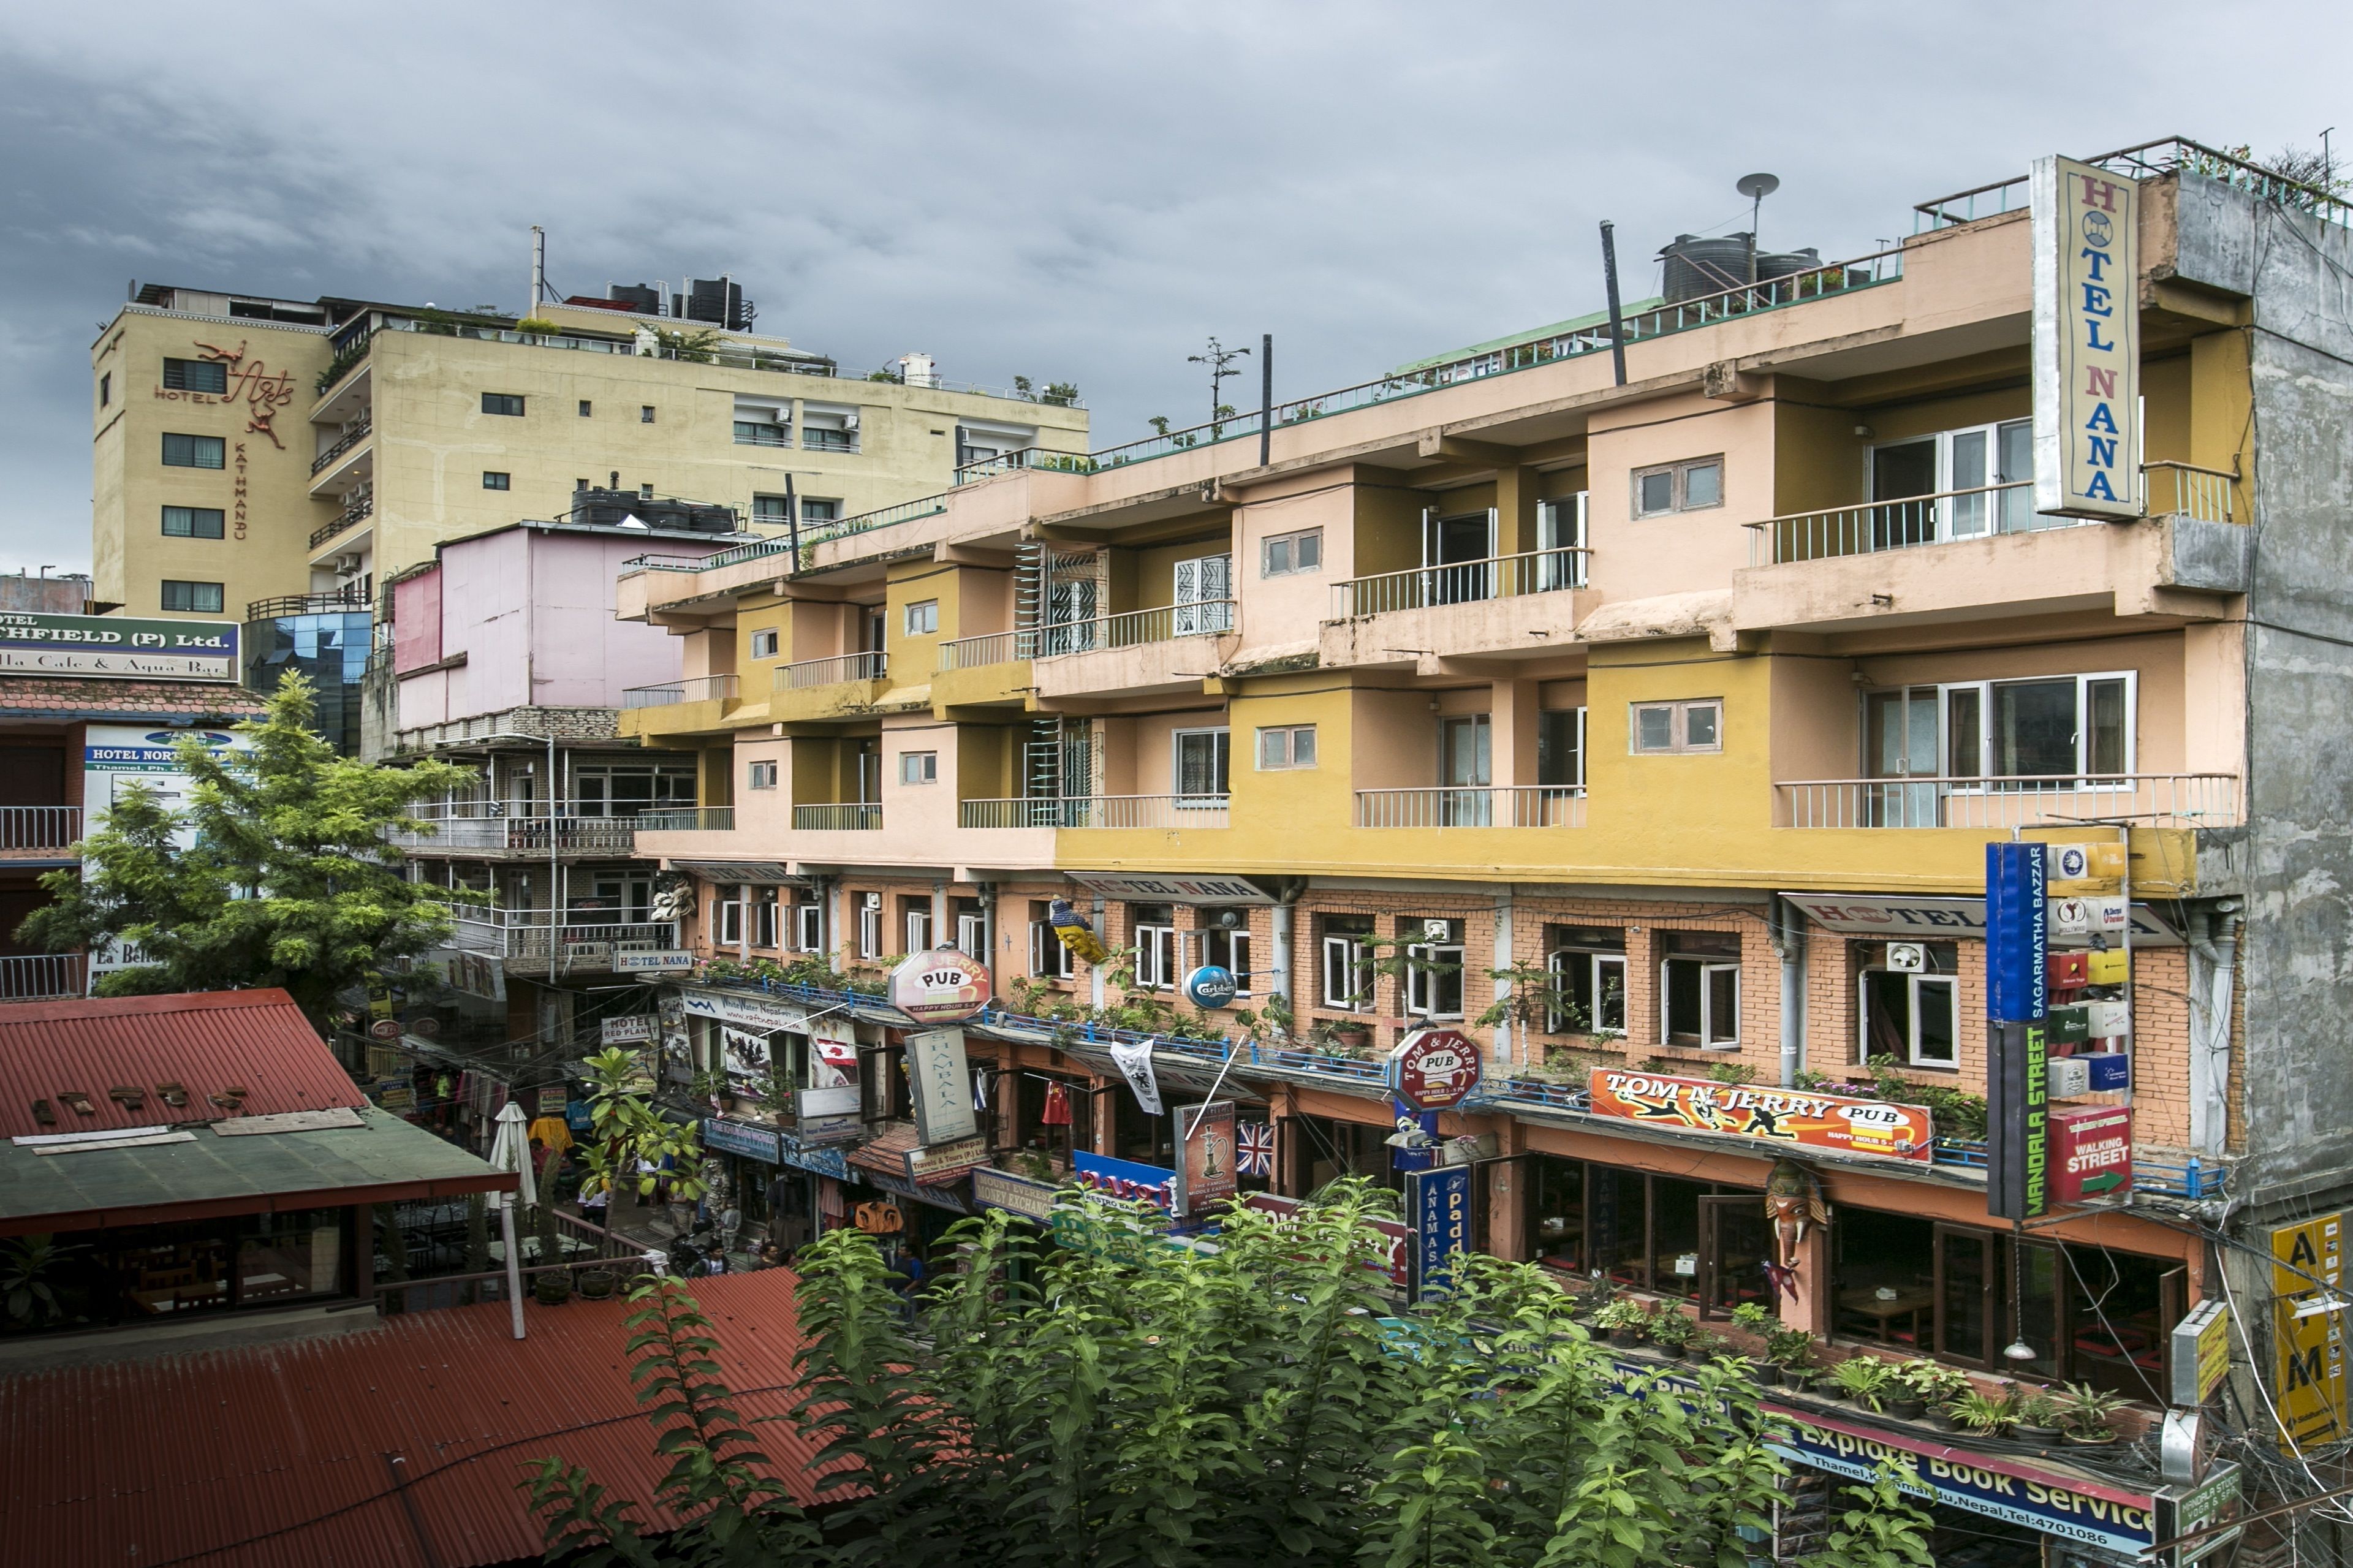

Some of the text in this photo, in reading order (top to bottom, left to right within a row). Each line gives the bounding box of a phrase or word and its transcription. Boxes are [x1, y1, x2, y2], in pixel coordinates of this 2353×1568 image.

[154, 384, 218, 404] HOTEL
[2084, 365, 2119, 502] NANA
[234, 442, 247, 540] KATHMANDU
[131, 632, 166, 648] (P)
[175, 634, 230, 648] Ltd.
[38, 655, 83, 668] Cafe
[94, 657, 110, 669] &
[124, 659, 175, 673] Aqua
[188, 661, 222, 674] Bar
[93, 749, 140, 760] HOTEL
[1083, 879, 1259, 896] HOTEL NANA
[2030, 847, 2044, 1018] SAGARMATHA BAZZAR
[620, 956, 689, 966] HOTEL NANA
[936, 955, 987, 983] JERRY
[922, 972, 962, 988] PUB
[1197, 982, 1235, 998] Carlsberg
[760, 1002, 781, 1016] Nepal
[610, 1017, 651, 1029] HOTEL
[624, 1027, 657, 1036] PLANET
[1404, 1037, 1476, 1081] TOM & JERRY
[1425, 1056, 1455, 1068] PUB
[931, 1034, 957, 1109] SHAMBALA
[1606, 1074, 1836, 1119] TOM N JERRY
[1848, 1107, 1898, 1123] PUB
[2027, 1027, 2045, 1216] MANDALA STREET
[711, 1121, 724, 1132] THE
[752, 1130, 776, 1145] WORLD
[1827, 1131, 1854, 1141] HAPPY
[1855, 1135, 1880, 1145] HOUR
[925, 1138, 984, 1157] Raspa Nepal
[2075, 1137, 2124, 1156] WALKING
[912, 1159, 937, 1170] Travels
[945, 1153, 964, 1162] Tours
[2067, 1145, 2130, 1173] STREET
[977, 1185, 1006, 1204] MONEY
[980, 1175, 1010, 1191] MOUNT
[1012, 1184, 1053, 1203] EVEREST
[1802, 1428, 1919, 1471] Explore
[1928, 1456, 2017, 1497] Book
[2182, 1472, 2240, 1513] MANDALA STUDIO
[2188, 1487, 2237, 1520] YOGA & SPA
